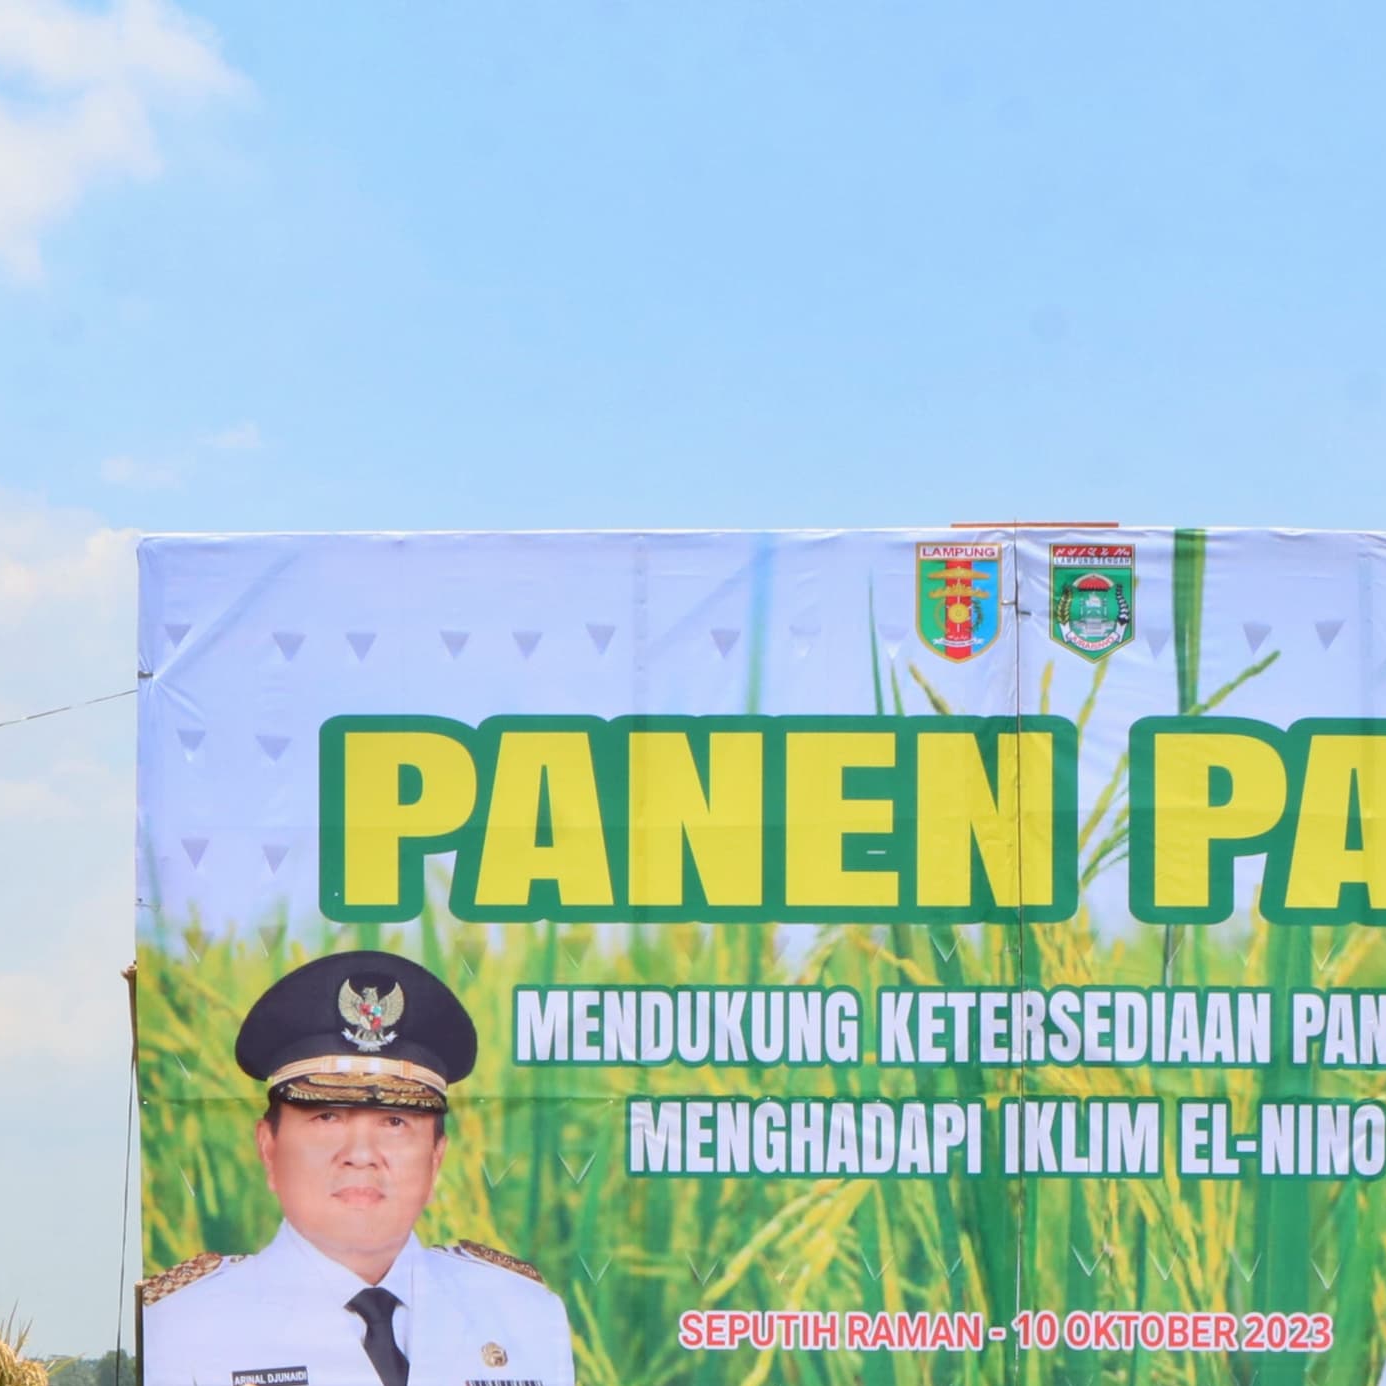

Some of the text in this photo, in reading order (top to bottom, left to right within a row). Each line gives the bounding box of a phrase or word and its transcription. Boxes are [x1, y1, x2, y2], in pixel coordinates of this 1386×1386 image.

[922, 547, 995, 557] LAMPUNG
[345, 731, 1053, 908] PANEN
[516, 990, 859, 1062] MENDUKUNG
[880, 991, 1271, 1063] KETERSEDIAAN
[629, 1101, 1386, 1175] MENGHADAPI IKLIM EL-NINO
[680, 1311, 837, 1348] SEPUTIH
[846, 1312, 982, 1349] RAMAN
[1013, 1311, 1057, 1348] 10
[1065, 1312, 1237, 1349] OKTOBER
[1242, 1314, 1333, 1350] 2023
[267, 1371, 306, 1384] DJUNAIDI
